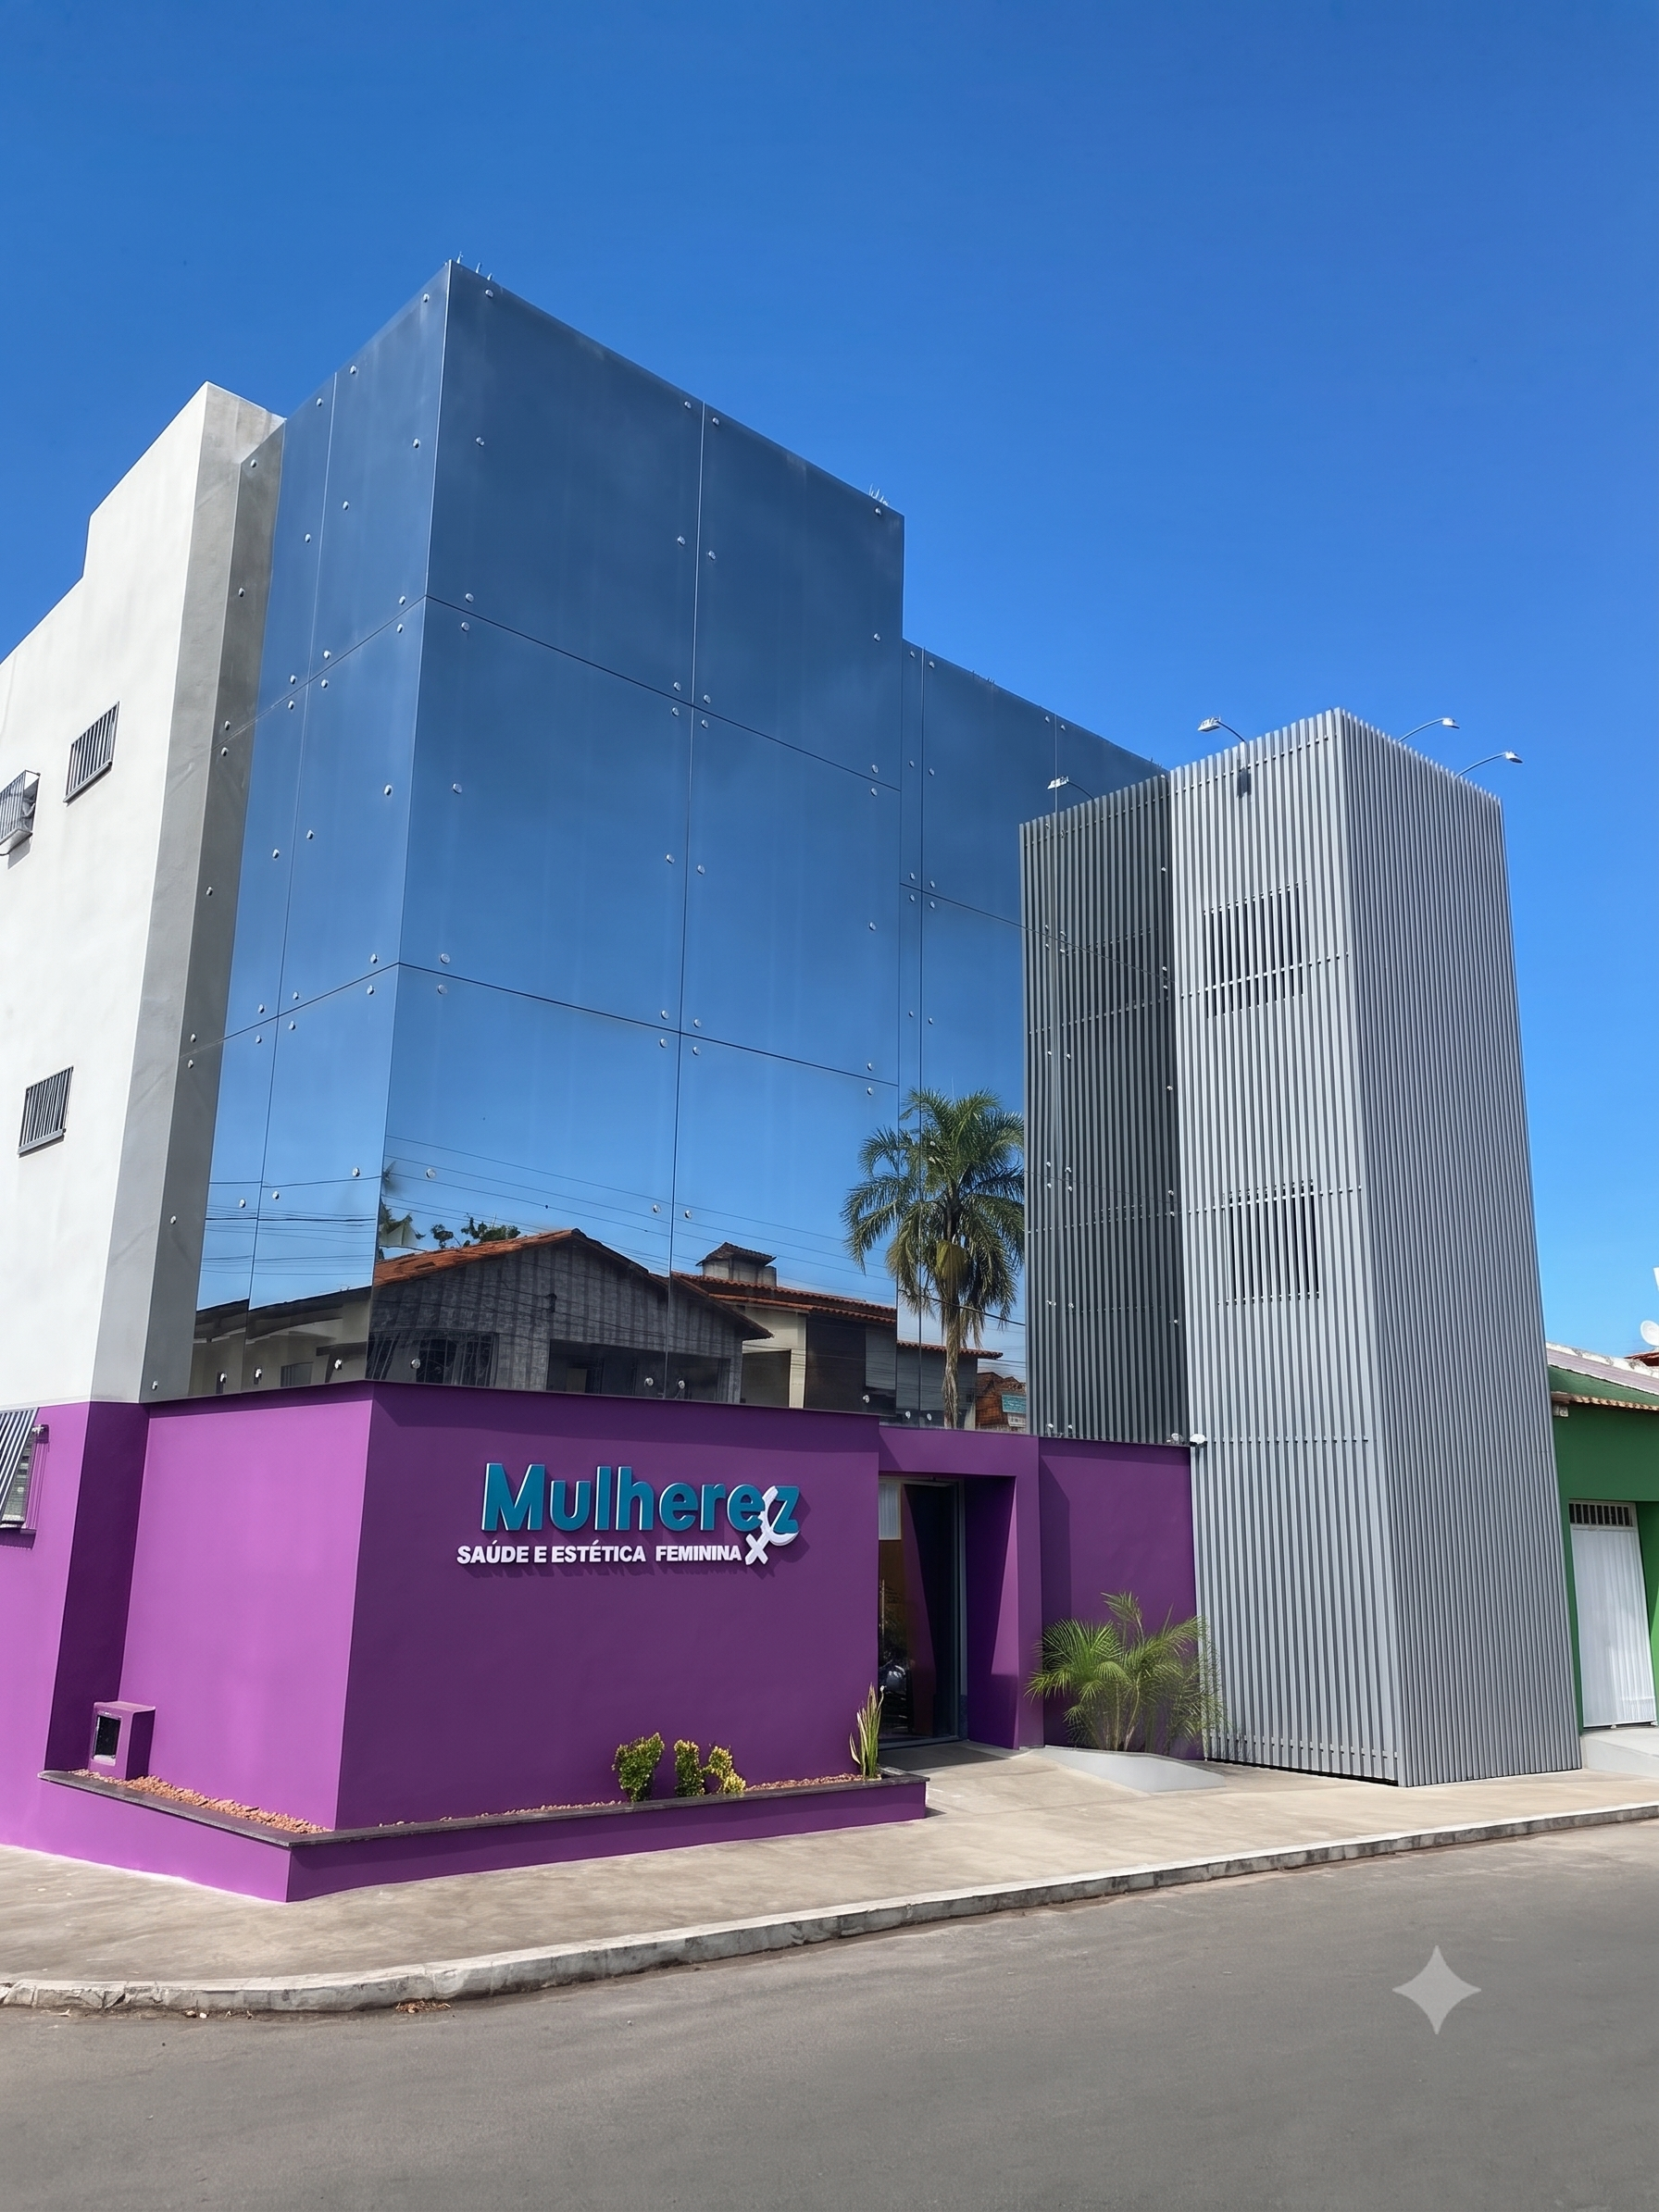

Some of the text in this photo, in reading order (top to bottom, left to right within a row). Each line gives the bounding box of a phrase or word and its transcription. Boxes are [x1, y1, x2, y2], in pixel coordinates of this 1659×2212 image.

[481, 1462, 800, 1533] Mulherez
[456, 1539, 742, 1564] SAÚDE E ESTÉTICA FEMININA
